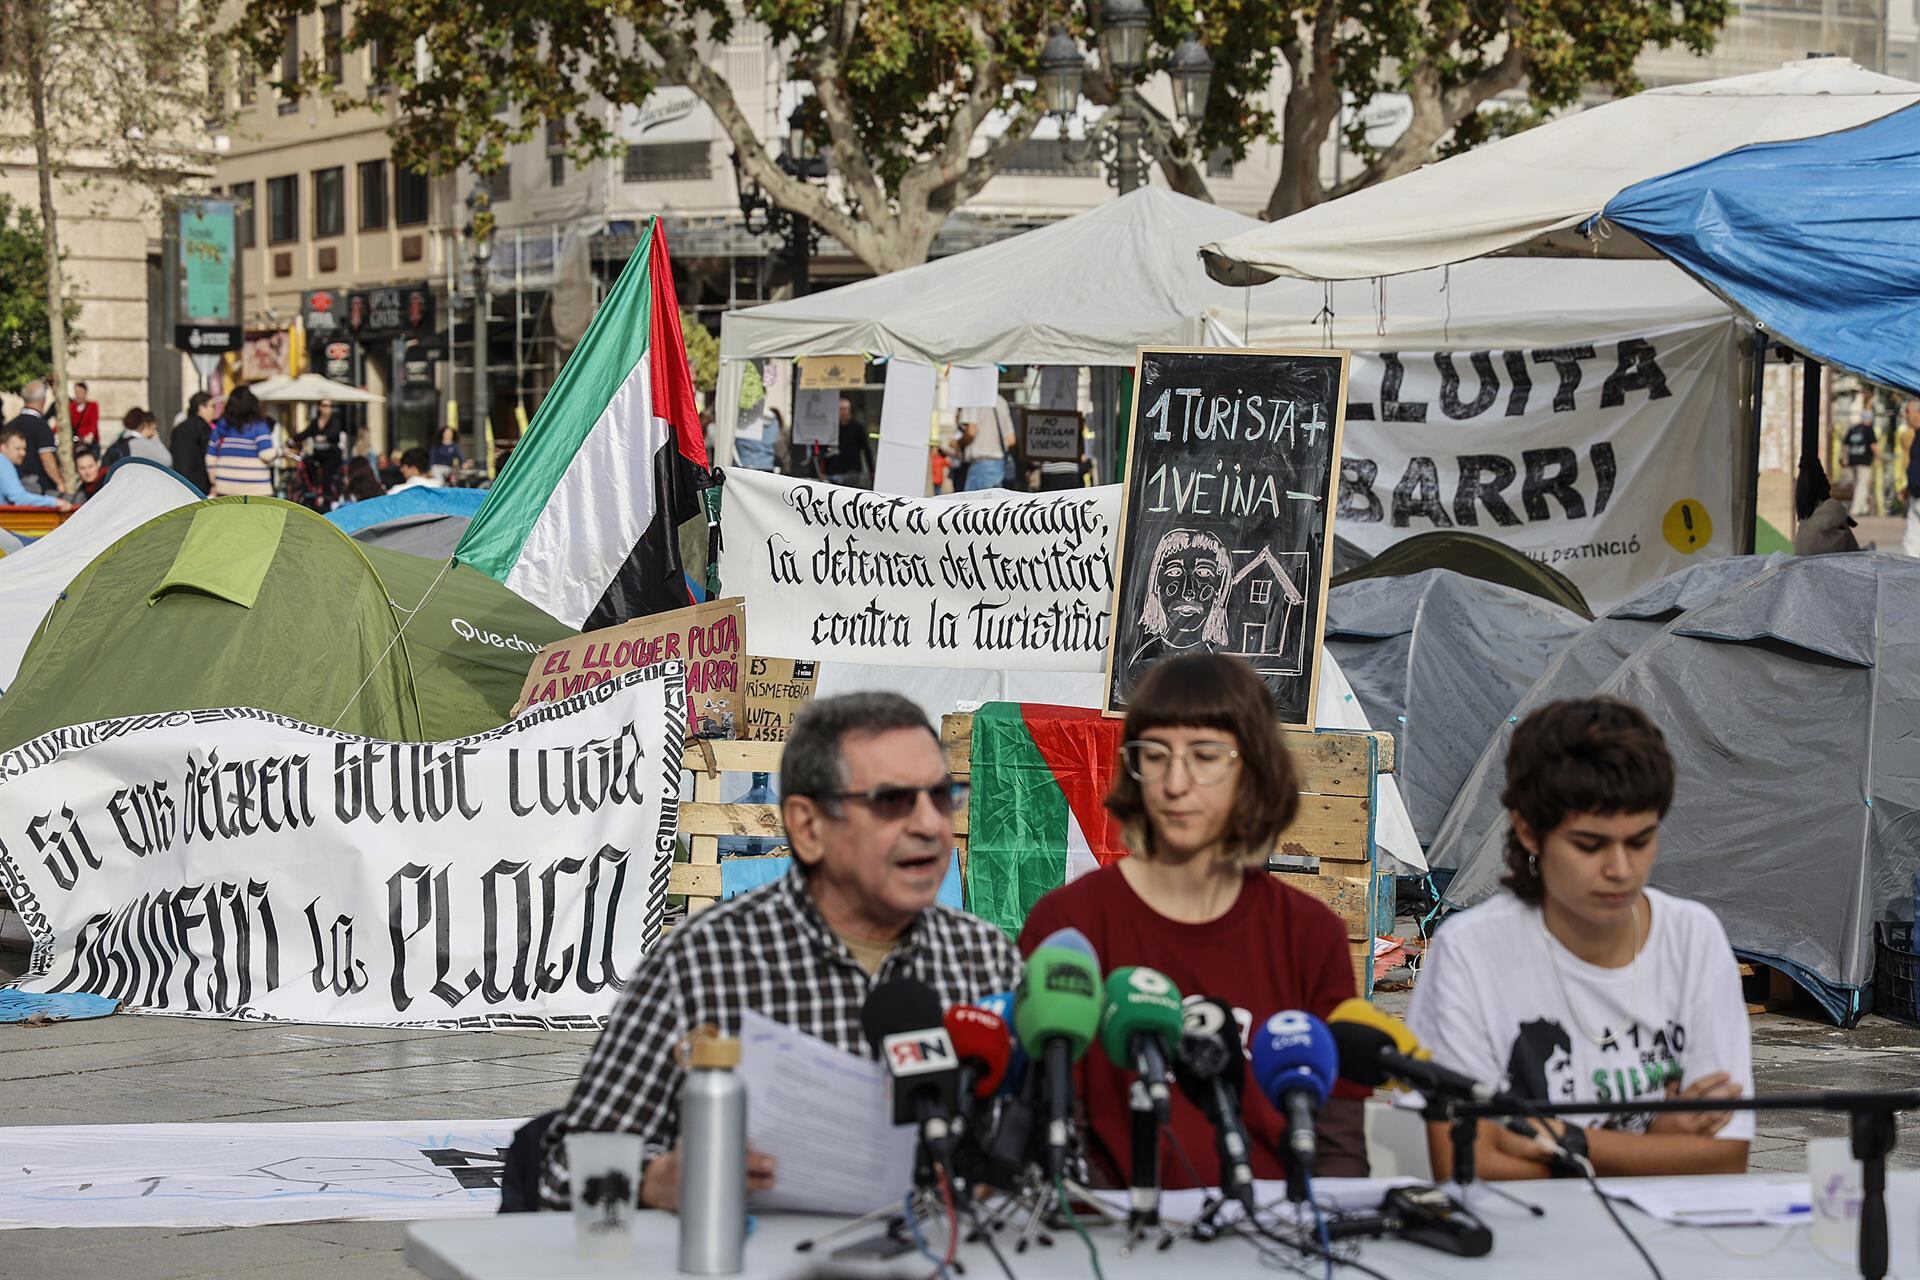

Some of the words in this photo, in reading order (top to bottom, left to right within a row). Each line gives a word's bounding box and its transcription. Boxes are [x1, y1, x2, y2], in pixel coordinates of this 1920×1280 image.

[1346, 338, 1671, 422] LUITA
[1337, 442, 1617, 528] BARRI
[767, 533, 803, 587] la
[812, 532, 935, 588] defensa
[939, 540, 987, 591] del
[1552, 534, 1640, 563] D'EXTINCIÓ
[542, 650, 571, 676] EL
[688, 614, 740, 660] PUJA
[811, 594, 912, 647] contra
[927, 596, 960, 649] la
[528, 680, 556, 705] LA
[684, 653, 738, 693] ARRI
[748, 708, 782, 727] LUITA
[25, 801, 103, 890] Si
[304, 896, 369, 997] la
